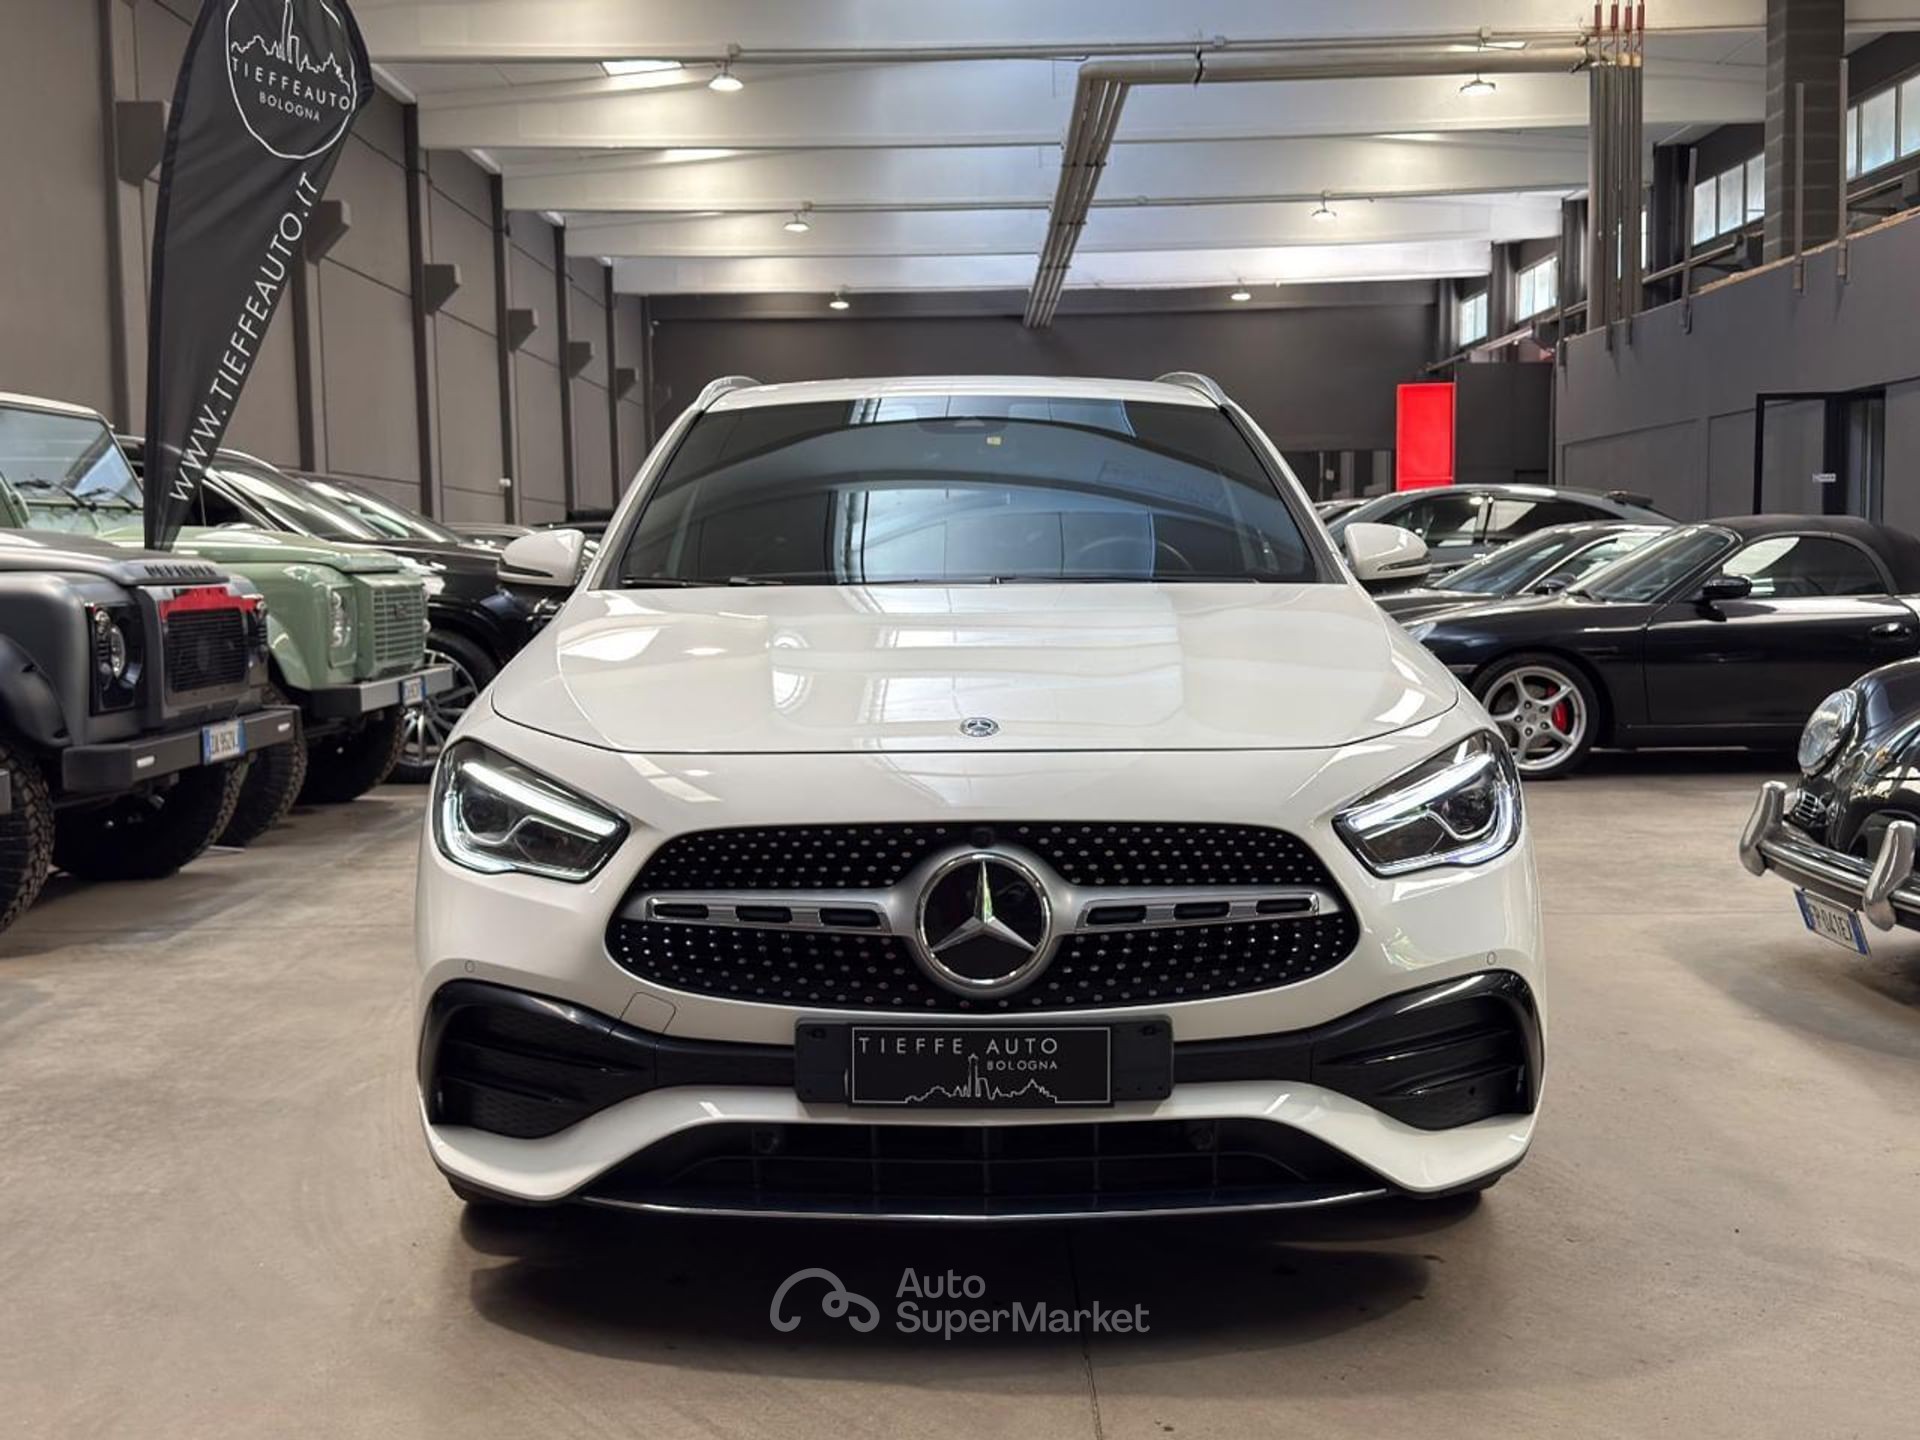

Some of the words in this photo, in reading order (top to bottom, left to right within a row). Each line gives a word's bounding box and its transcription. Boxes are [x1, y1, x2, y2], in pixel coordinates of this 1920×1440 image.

[231, 56, 351, 111] TIEFFEAUTO
[259, 91, 321, 122] BOLOGNA
[169, 172, 318, 501] WWW.TIEFFEAUTO.IT
[858, 1037, 963, 1055] TIEFFE
[985, 1037, 1058, 1055] AUTO
[986, 1060, 1058, 1071] BOLOGNA
